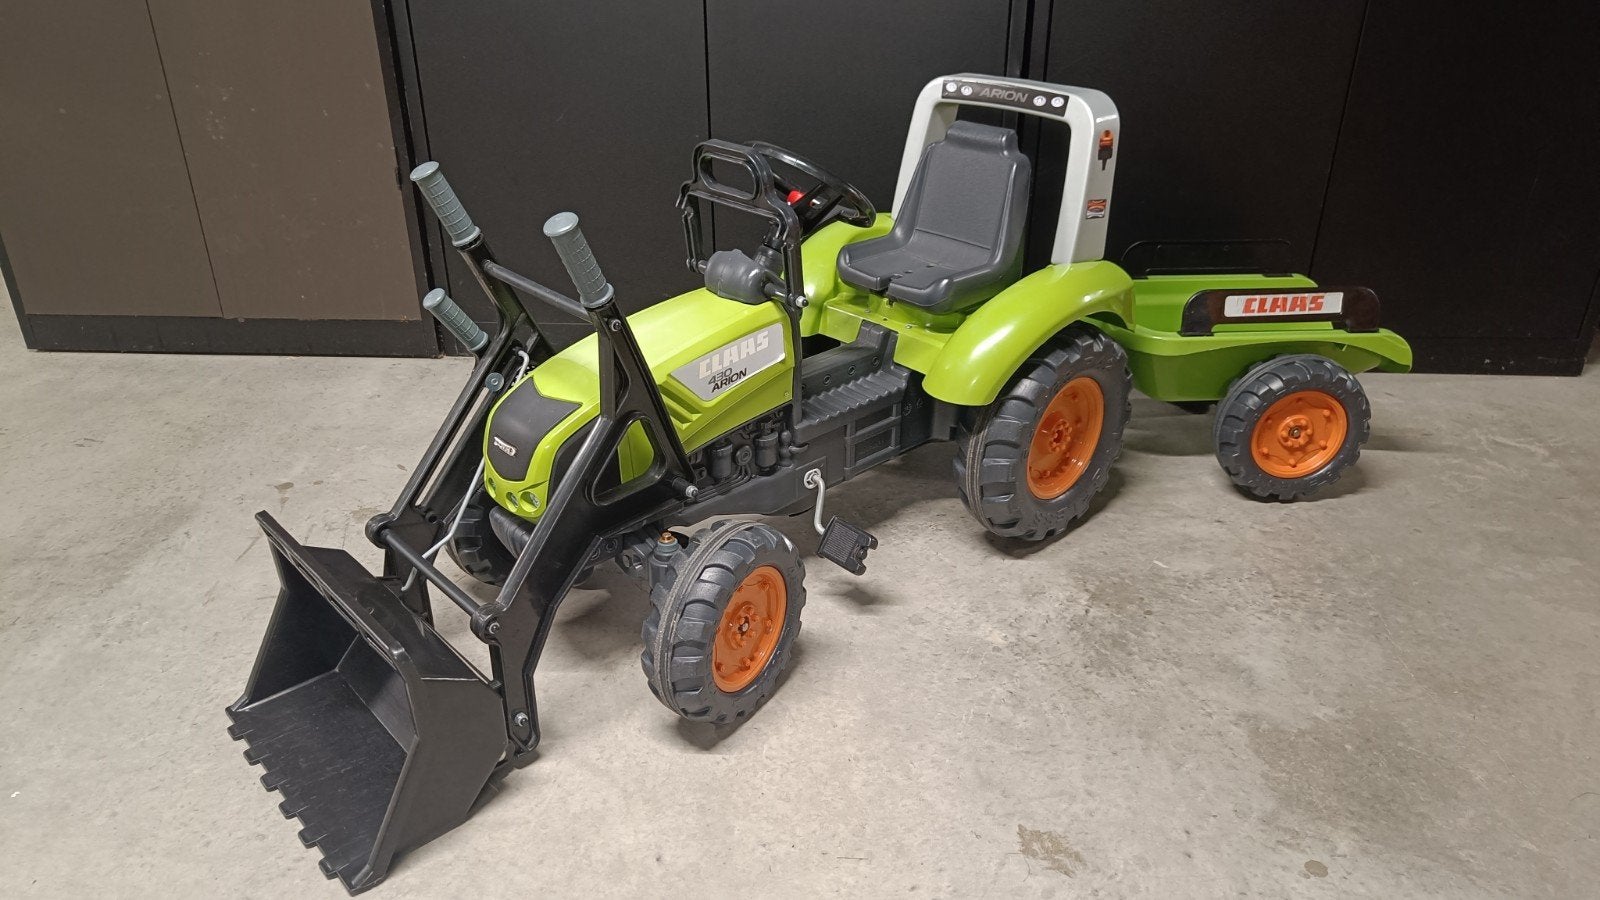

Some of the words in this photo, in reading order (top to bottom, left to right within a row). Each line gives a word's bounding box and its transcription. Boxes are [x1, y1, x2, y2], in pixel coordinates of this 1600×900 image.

[979, 87, 1028, 103] ARION
[1242, 295, 1325, 314] CLAAS
[699, 330, 769, 379] CLAAS
[708, 367, 733, 385] 430
[711, 368, 747, 393] ARION
